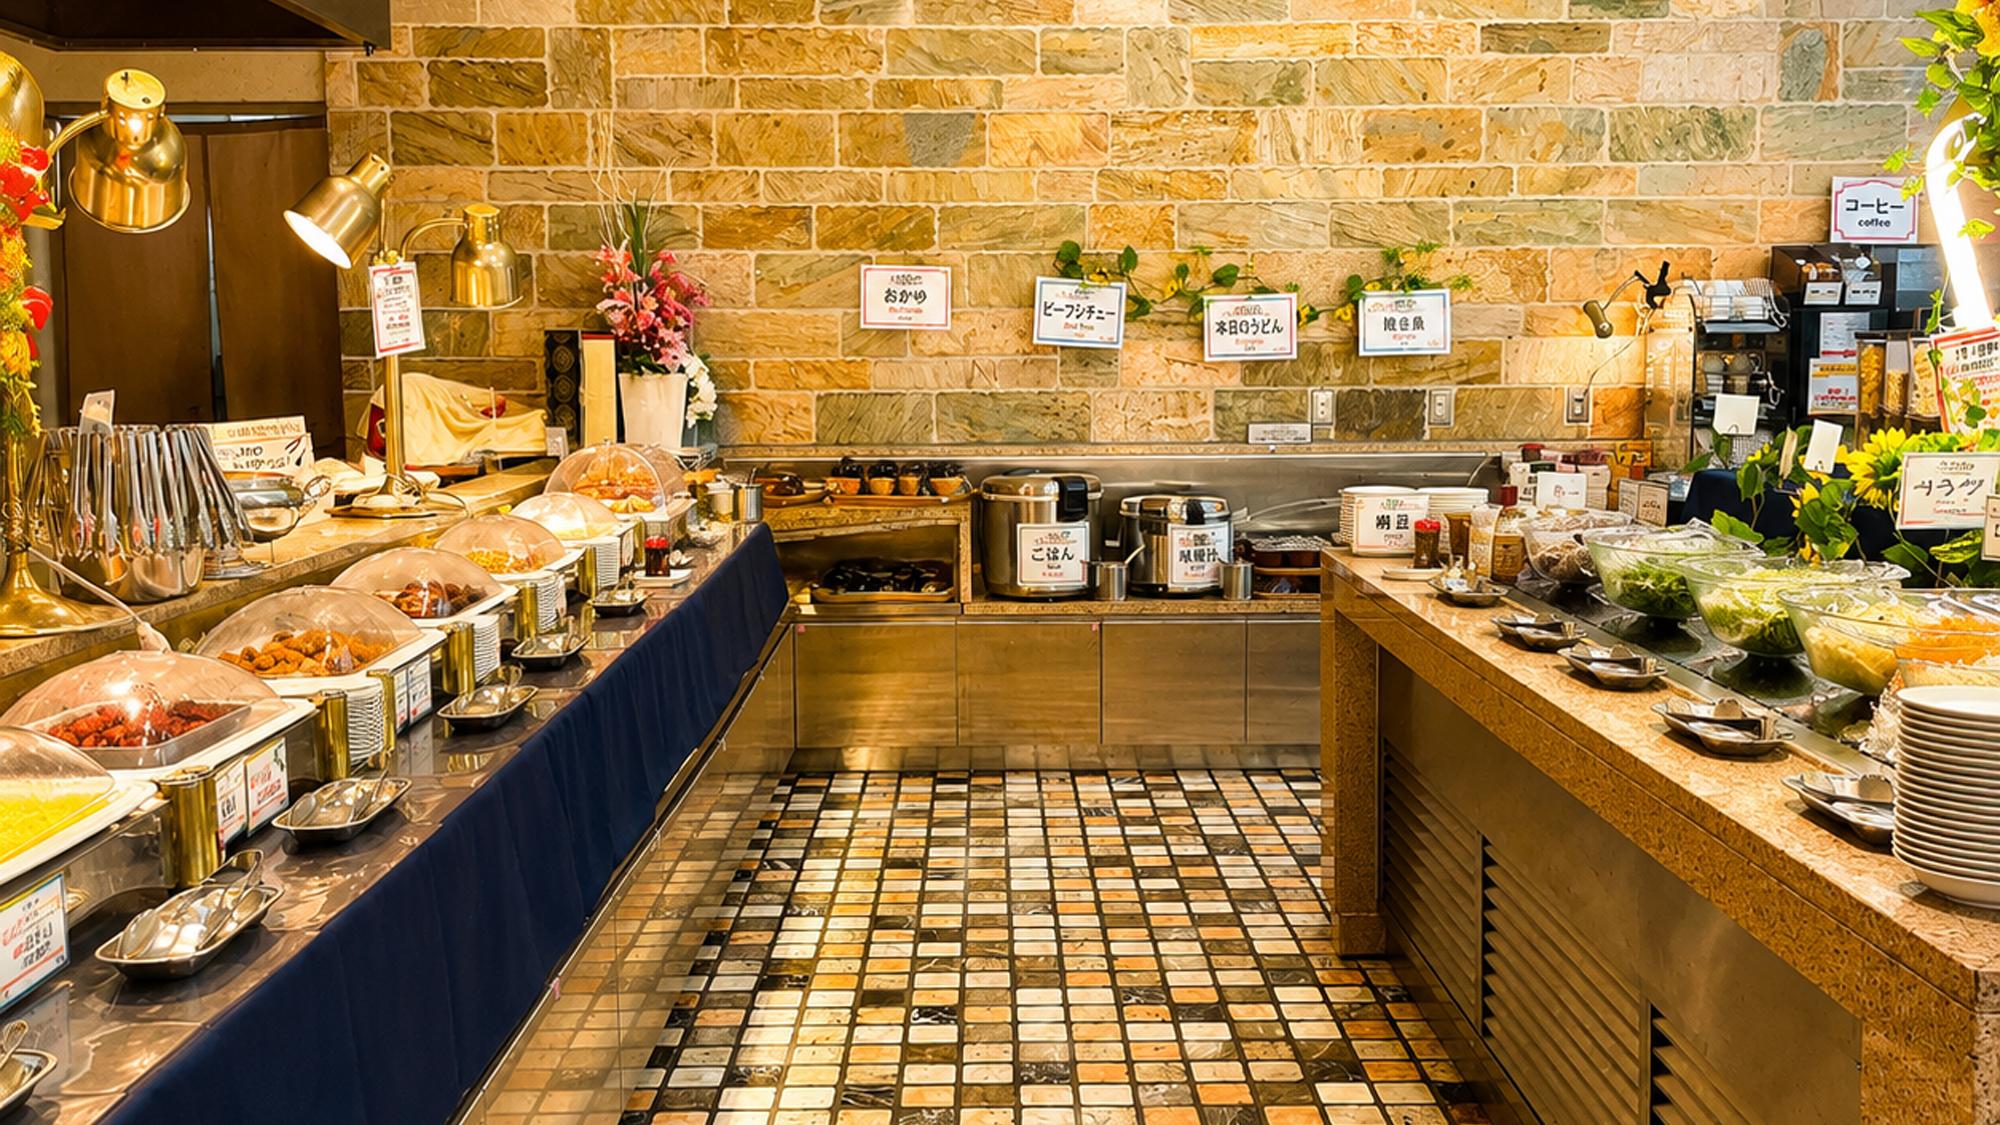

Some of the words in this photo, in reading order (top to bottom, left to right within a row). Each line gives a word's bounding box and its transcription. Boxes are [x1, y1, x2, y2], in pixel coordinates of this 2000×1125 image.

[1845, 197, 1905, 214] コーヒー
[1858, 218, 1891, 227] coffee
[1215, 318, 1284, 335] 本日のうどん
